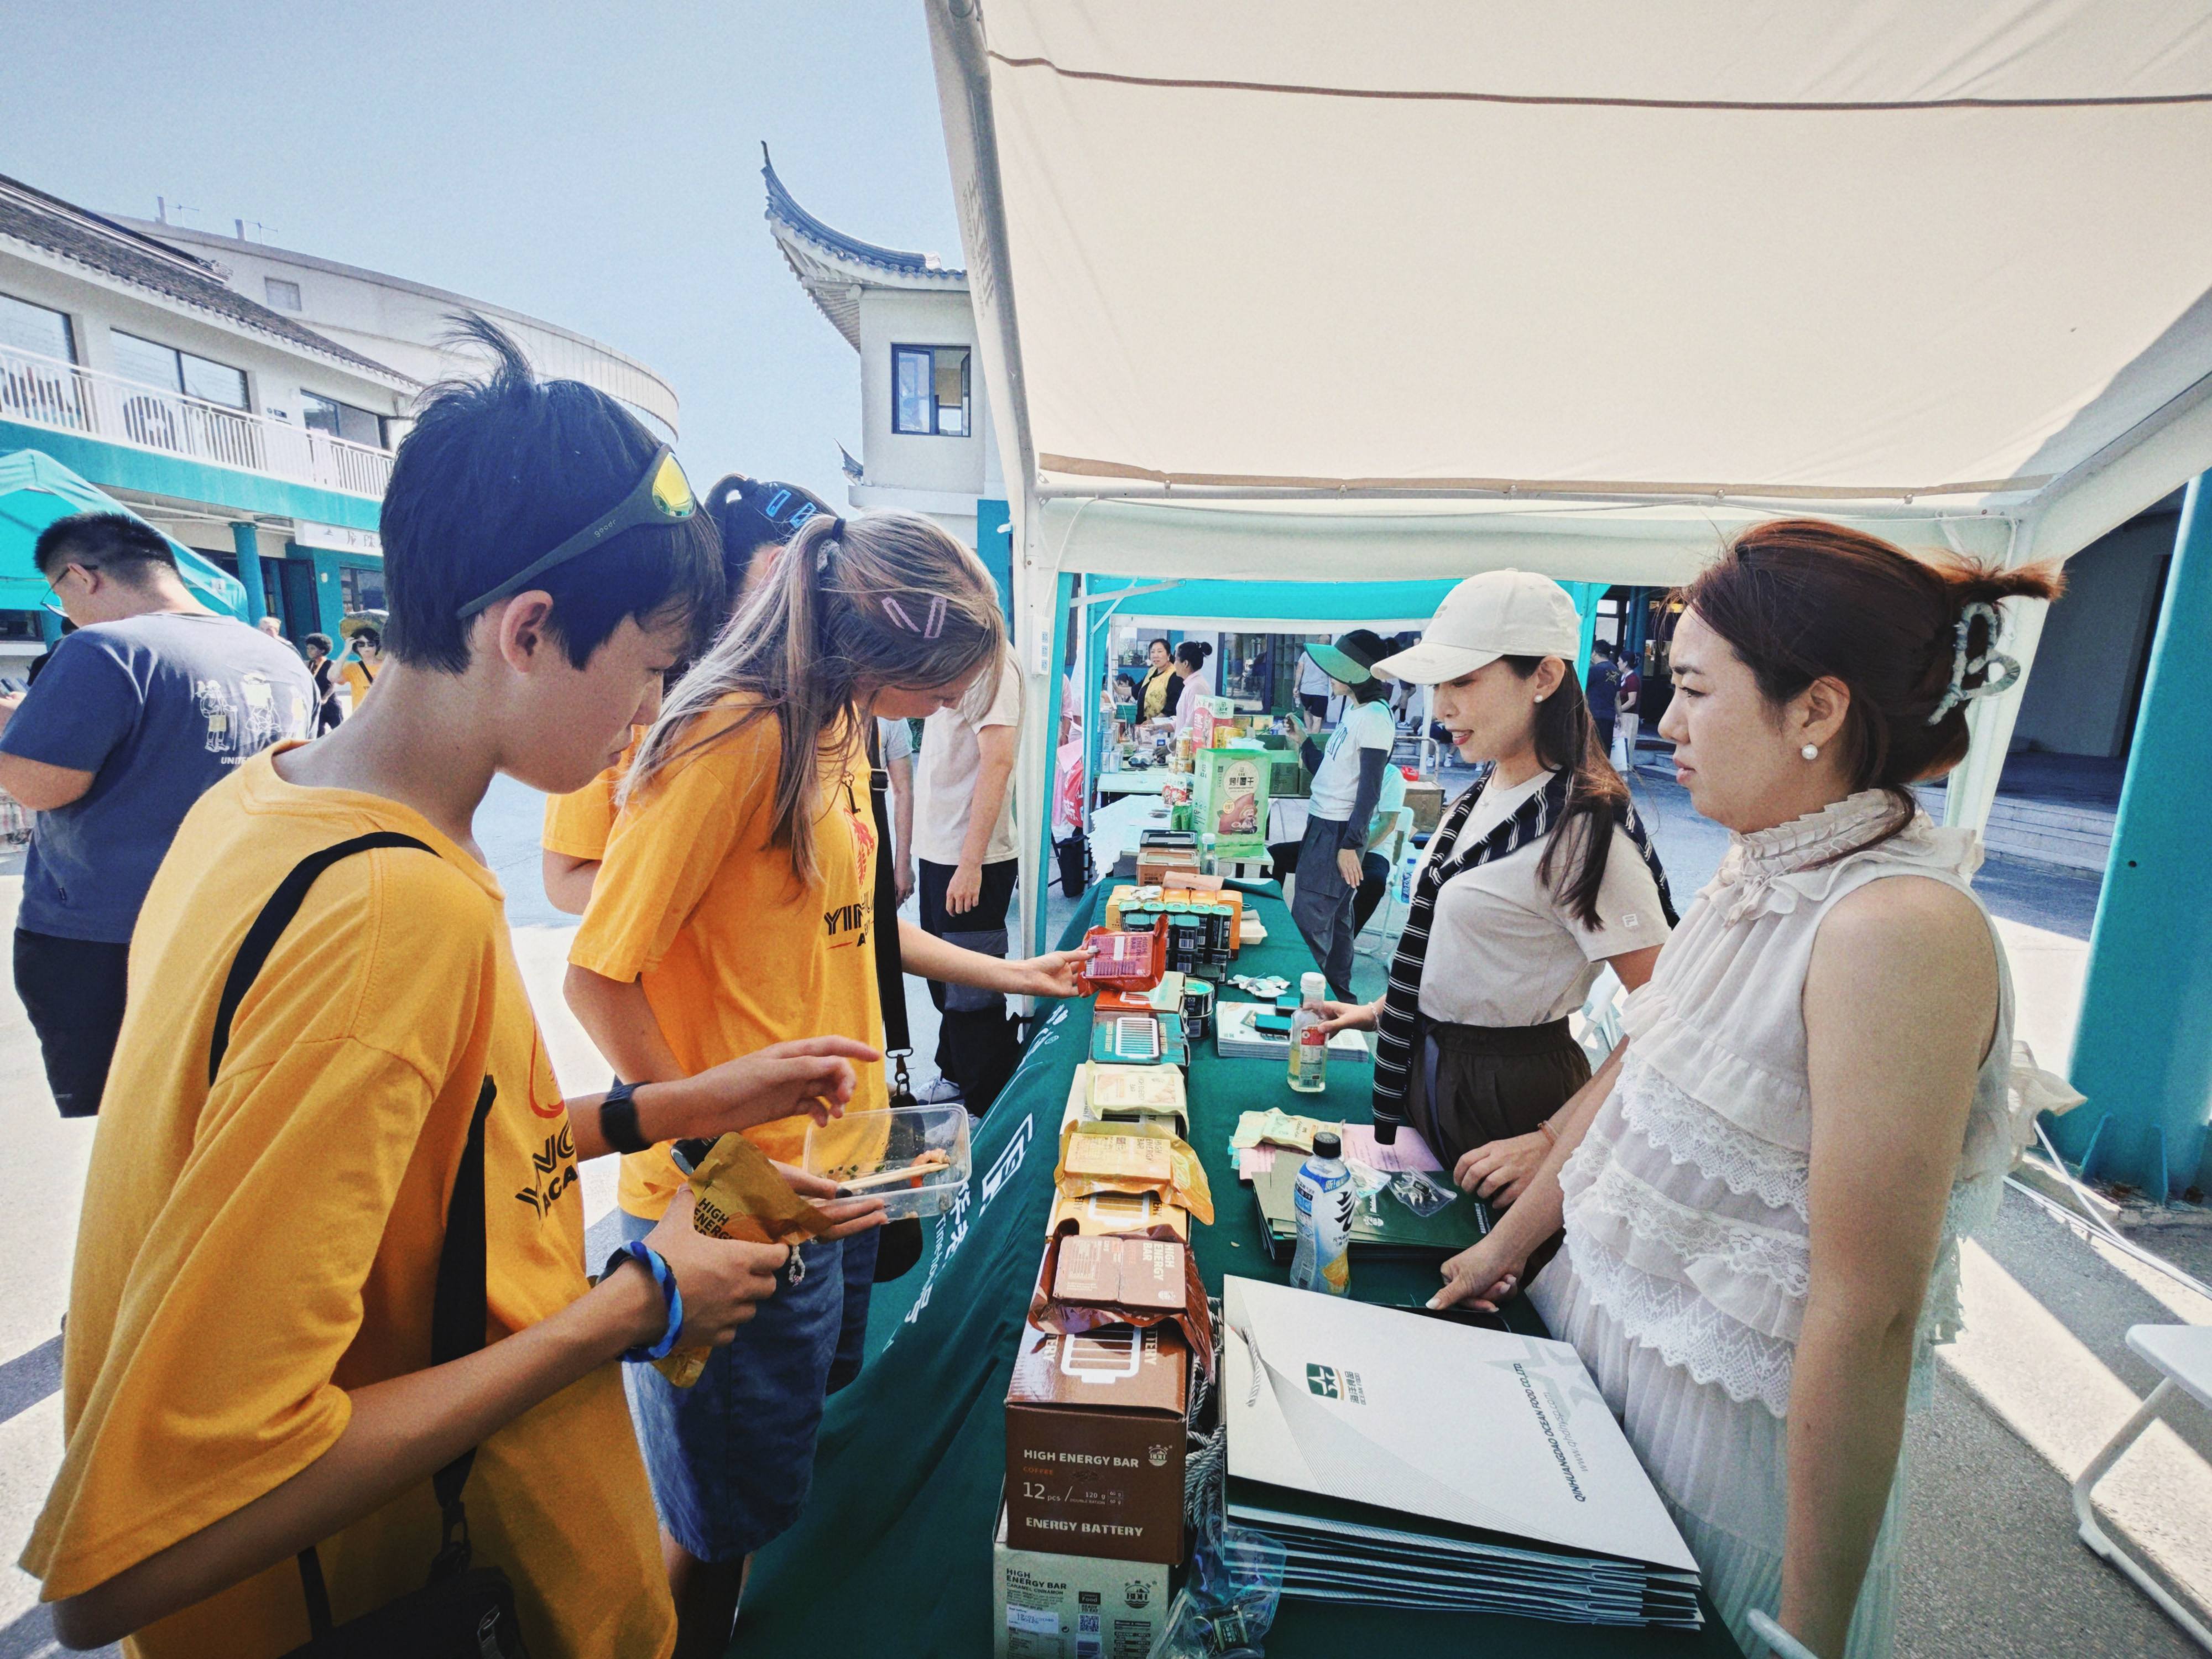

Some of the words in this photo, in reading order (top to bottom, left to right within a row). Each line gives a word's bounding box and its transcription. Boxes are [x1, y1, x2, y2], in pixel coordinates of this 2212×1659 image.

[594, 519, 616, 538] goodr
[698, 1198, 729, 1226] HIGH
[693, 1208, 734, 1239] ENERG
[1143, 1243, 1152, 1261] BAR
[1165, 1244, 1175, 1267] HIGH
[1154, 1243, 1164, 1281] ENERGY
[1144, 1330, 1158, 1366] TTERY
[1525, 1388, 1541, 1411] FOOD
[1535, 1410, 1554, 1437] OCEAN
[1024, 1449, 1055, 1461] HIGH
[1060, 1453, 1110, 1465] ENERGY
[1113, 1457, 1139, 1467] BAR
[1023, 1467, 1053, 1475] COFFEE
[1548, 1437, 1586, 1502] QINHUANGDAO
[1023, 1482, 1045, 1499] 12
[1026, 1517, 1077, 1531] ENERGY
[1082, 1522, 1143, 1536] BATTERY
[1006, 1568, 1030, 1579] HIGH
[1006, 1575, 1045, 1588] ENERGY
[1006, 1583, 1032, 1592] CARAMEL
